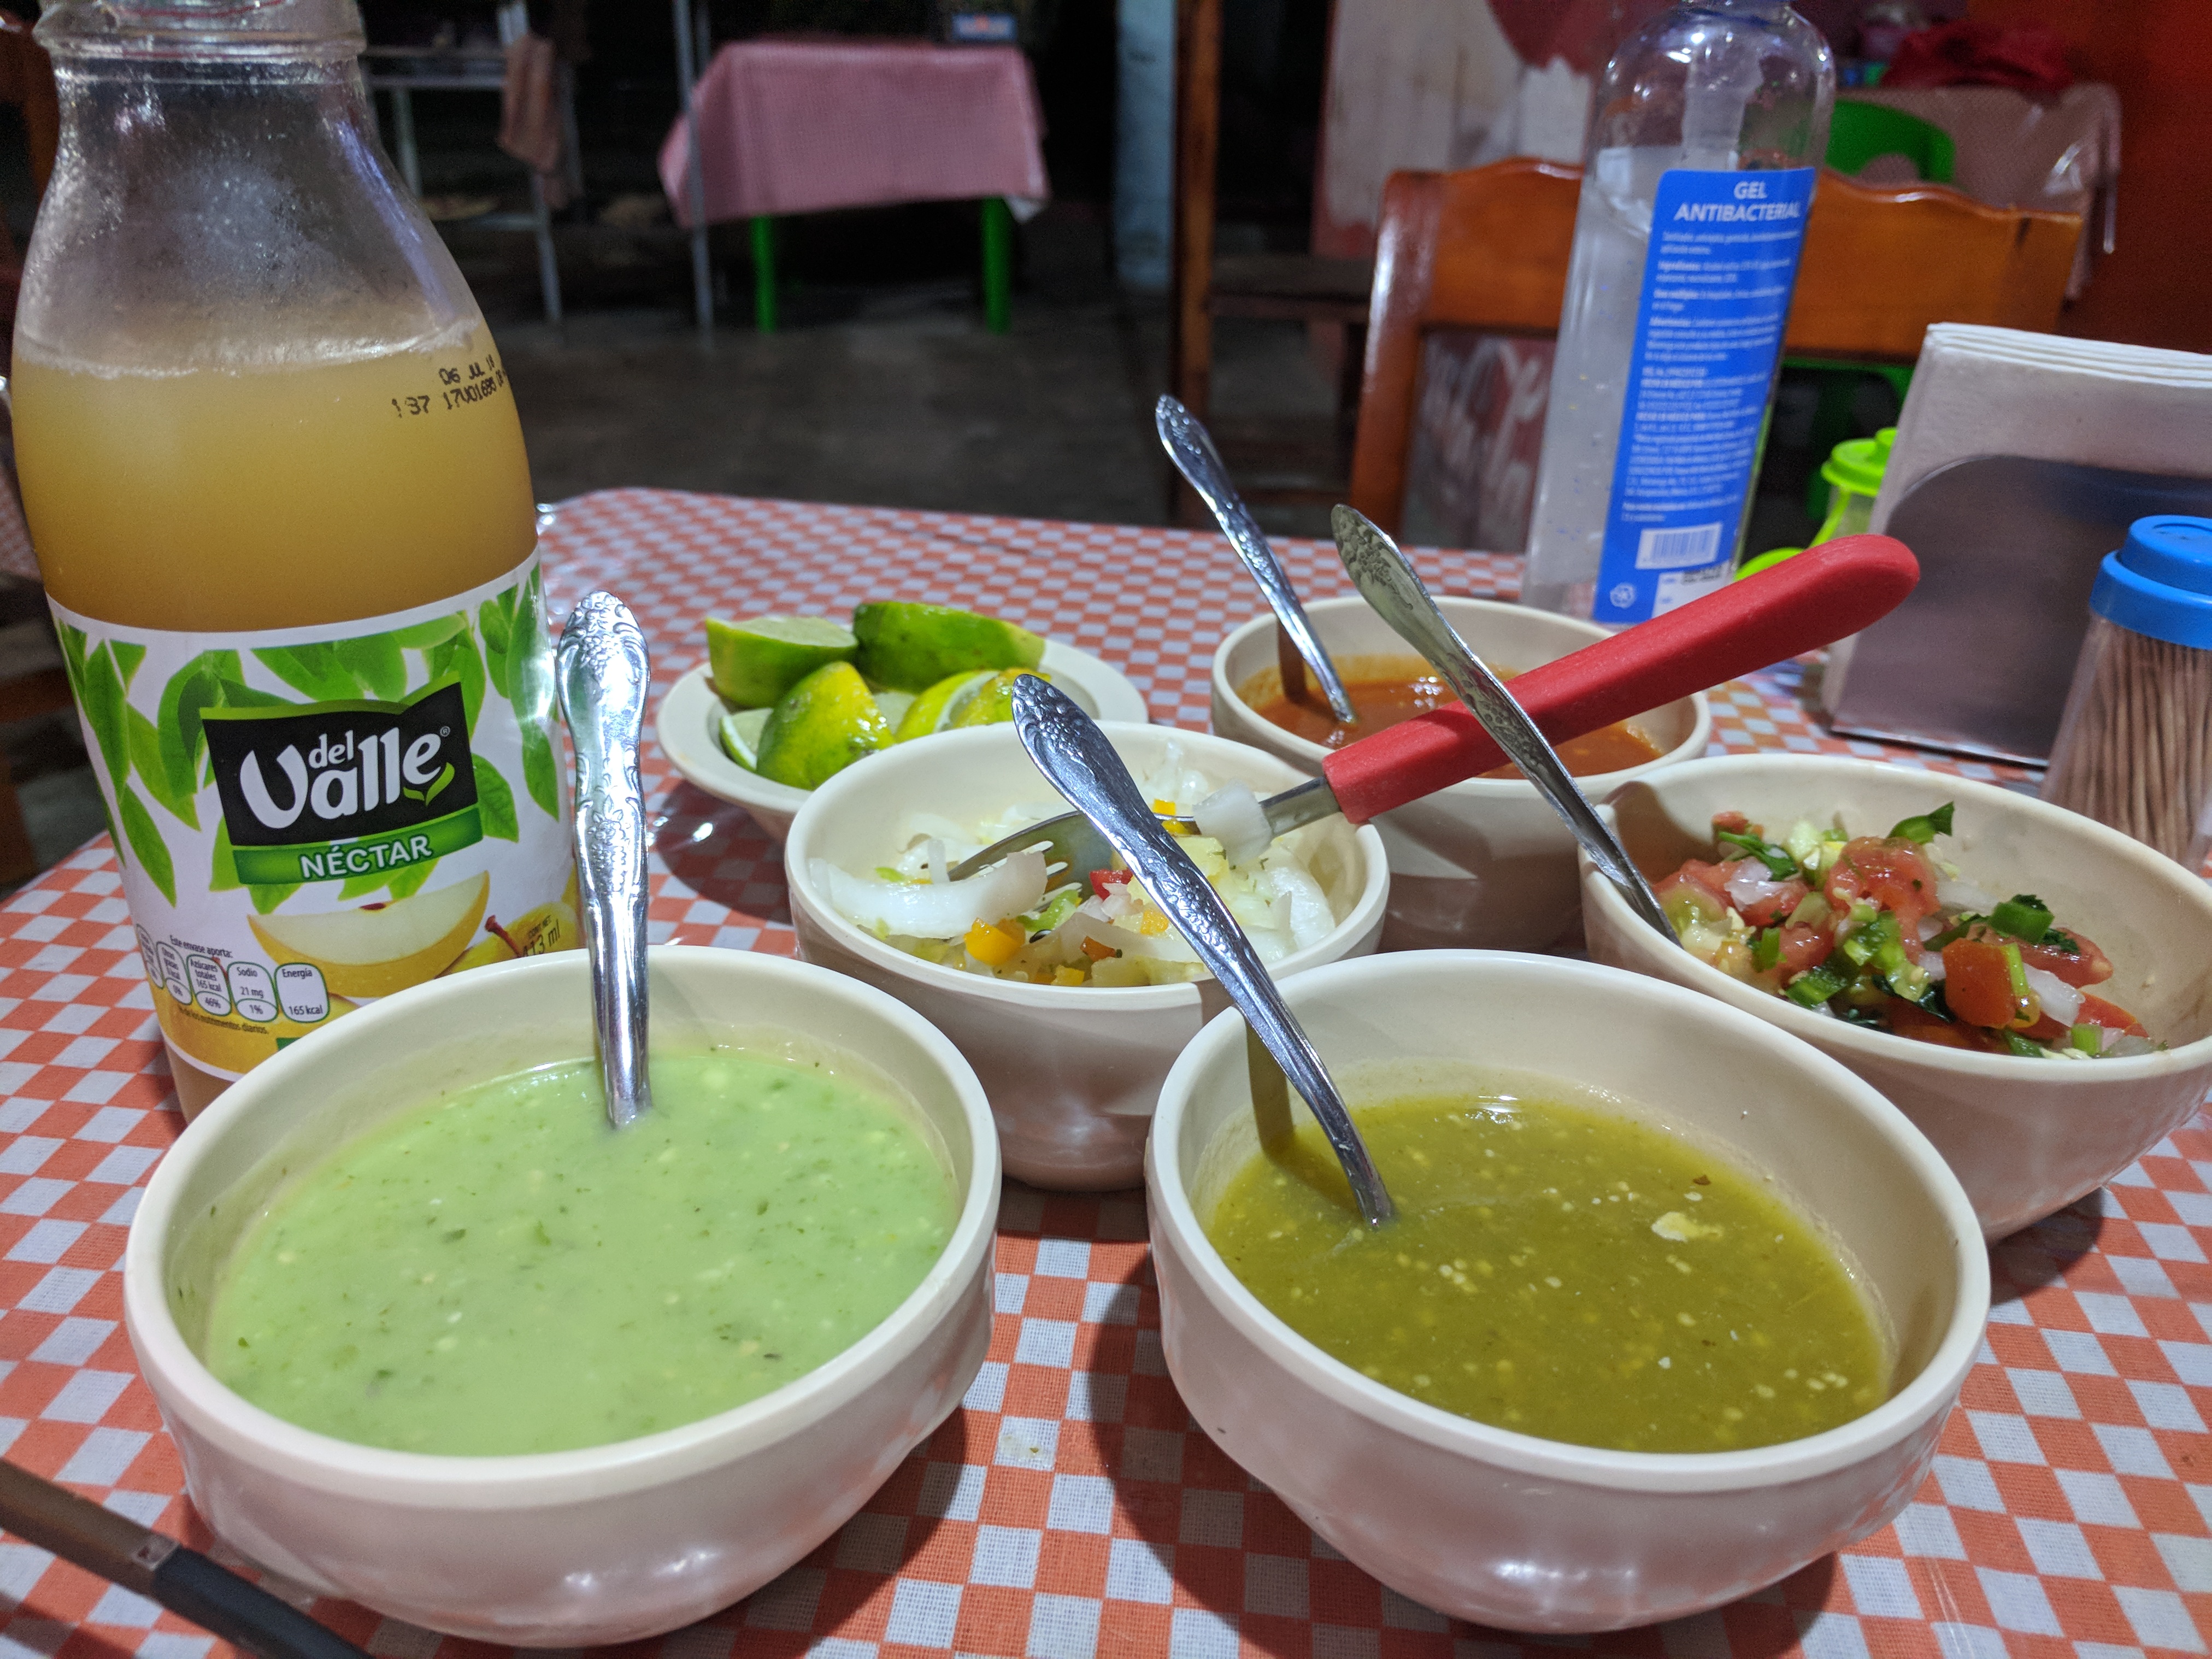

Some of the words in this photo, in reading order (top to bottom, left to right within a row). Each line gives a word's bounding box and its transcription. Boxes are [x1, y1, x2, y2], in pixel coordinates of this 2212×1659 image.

[1733, 181, 1768, 199] GEL
[1673, 201, 1801, 222] ANTIBACTERIAL
[308, 730, 354, 768] del
[239, 727, 442, 829] Valle
[301, 834, 433, 879] NÉCTAR
[548, 919, 561, 947] ml
[236, 967, 258, 978] Sodio
[282, 968, 313, 980] Energía
[239, 986, 250, 996] 21
[251, 989, 264, 999] mg
[249, 1004, 263, 1015] 1%
[288, 1005, 305, 1016] 165
[305, 1004, 323, 1015] kcal
